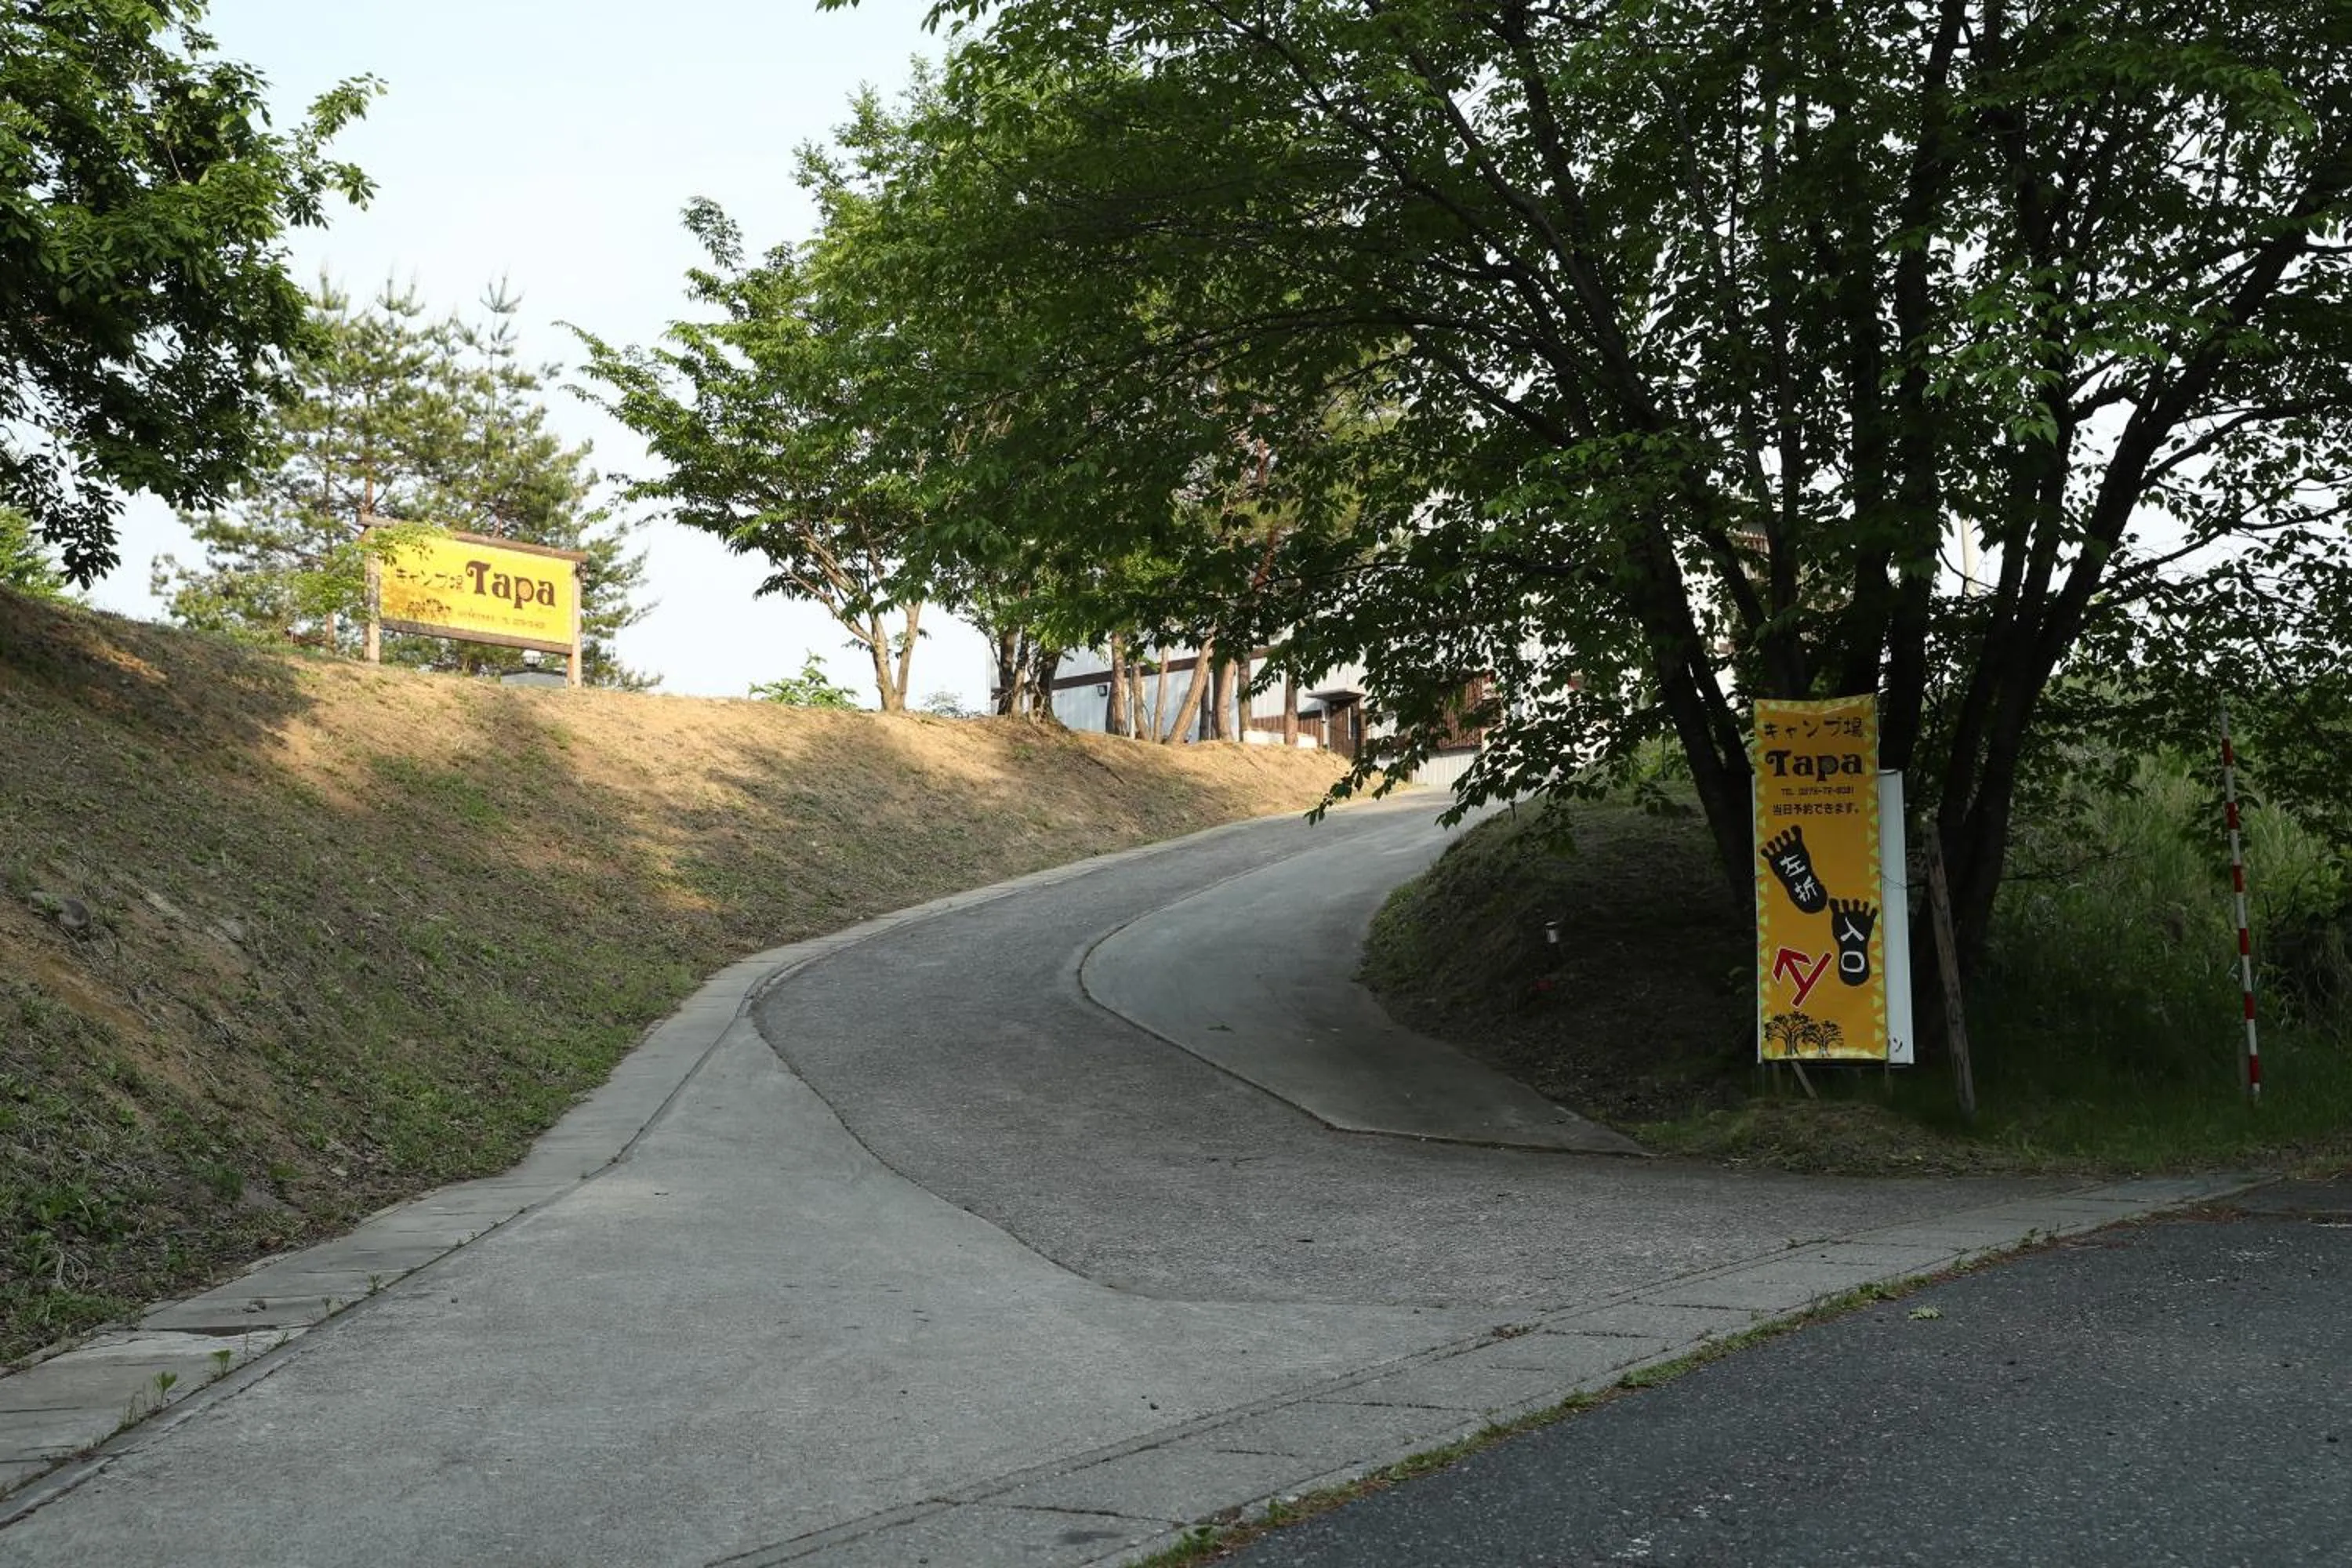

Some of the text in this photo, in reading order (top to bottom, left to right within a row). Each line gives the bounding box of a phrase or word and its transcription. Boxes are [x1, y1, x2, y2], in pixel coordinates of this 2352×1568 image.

[465, 560, 556, 609] Tapa
[1765, 717, 1864, 739] キャンプ場
[1766, 750, 1864, 782] Tapa
[1779, 854, 1818, 902] 左折
[1840, 916, 1865, 973] 入口
